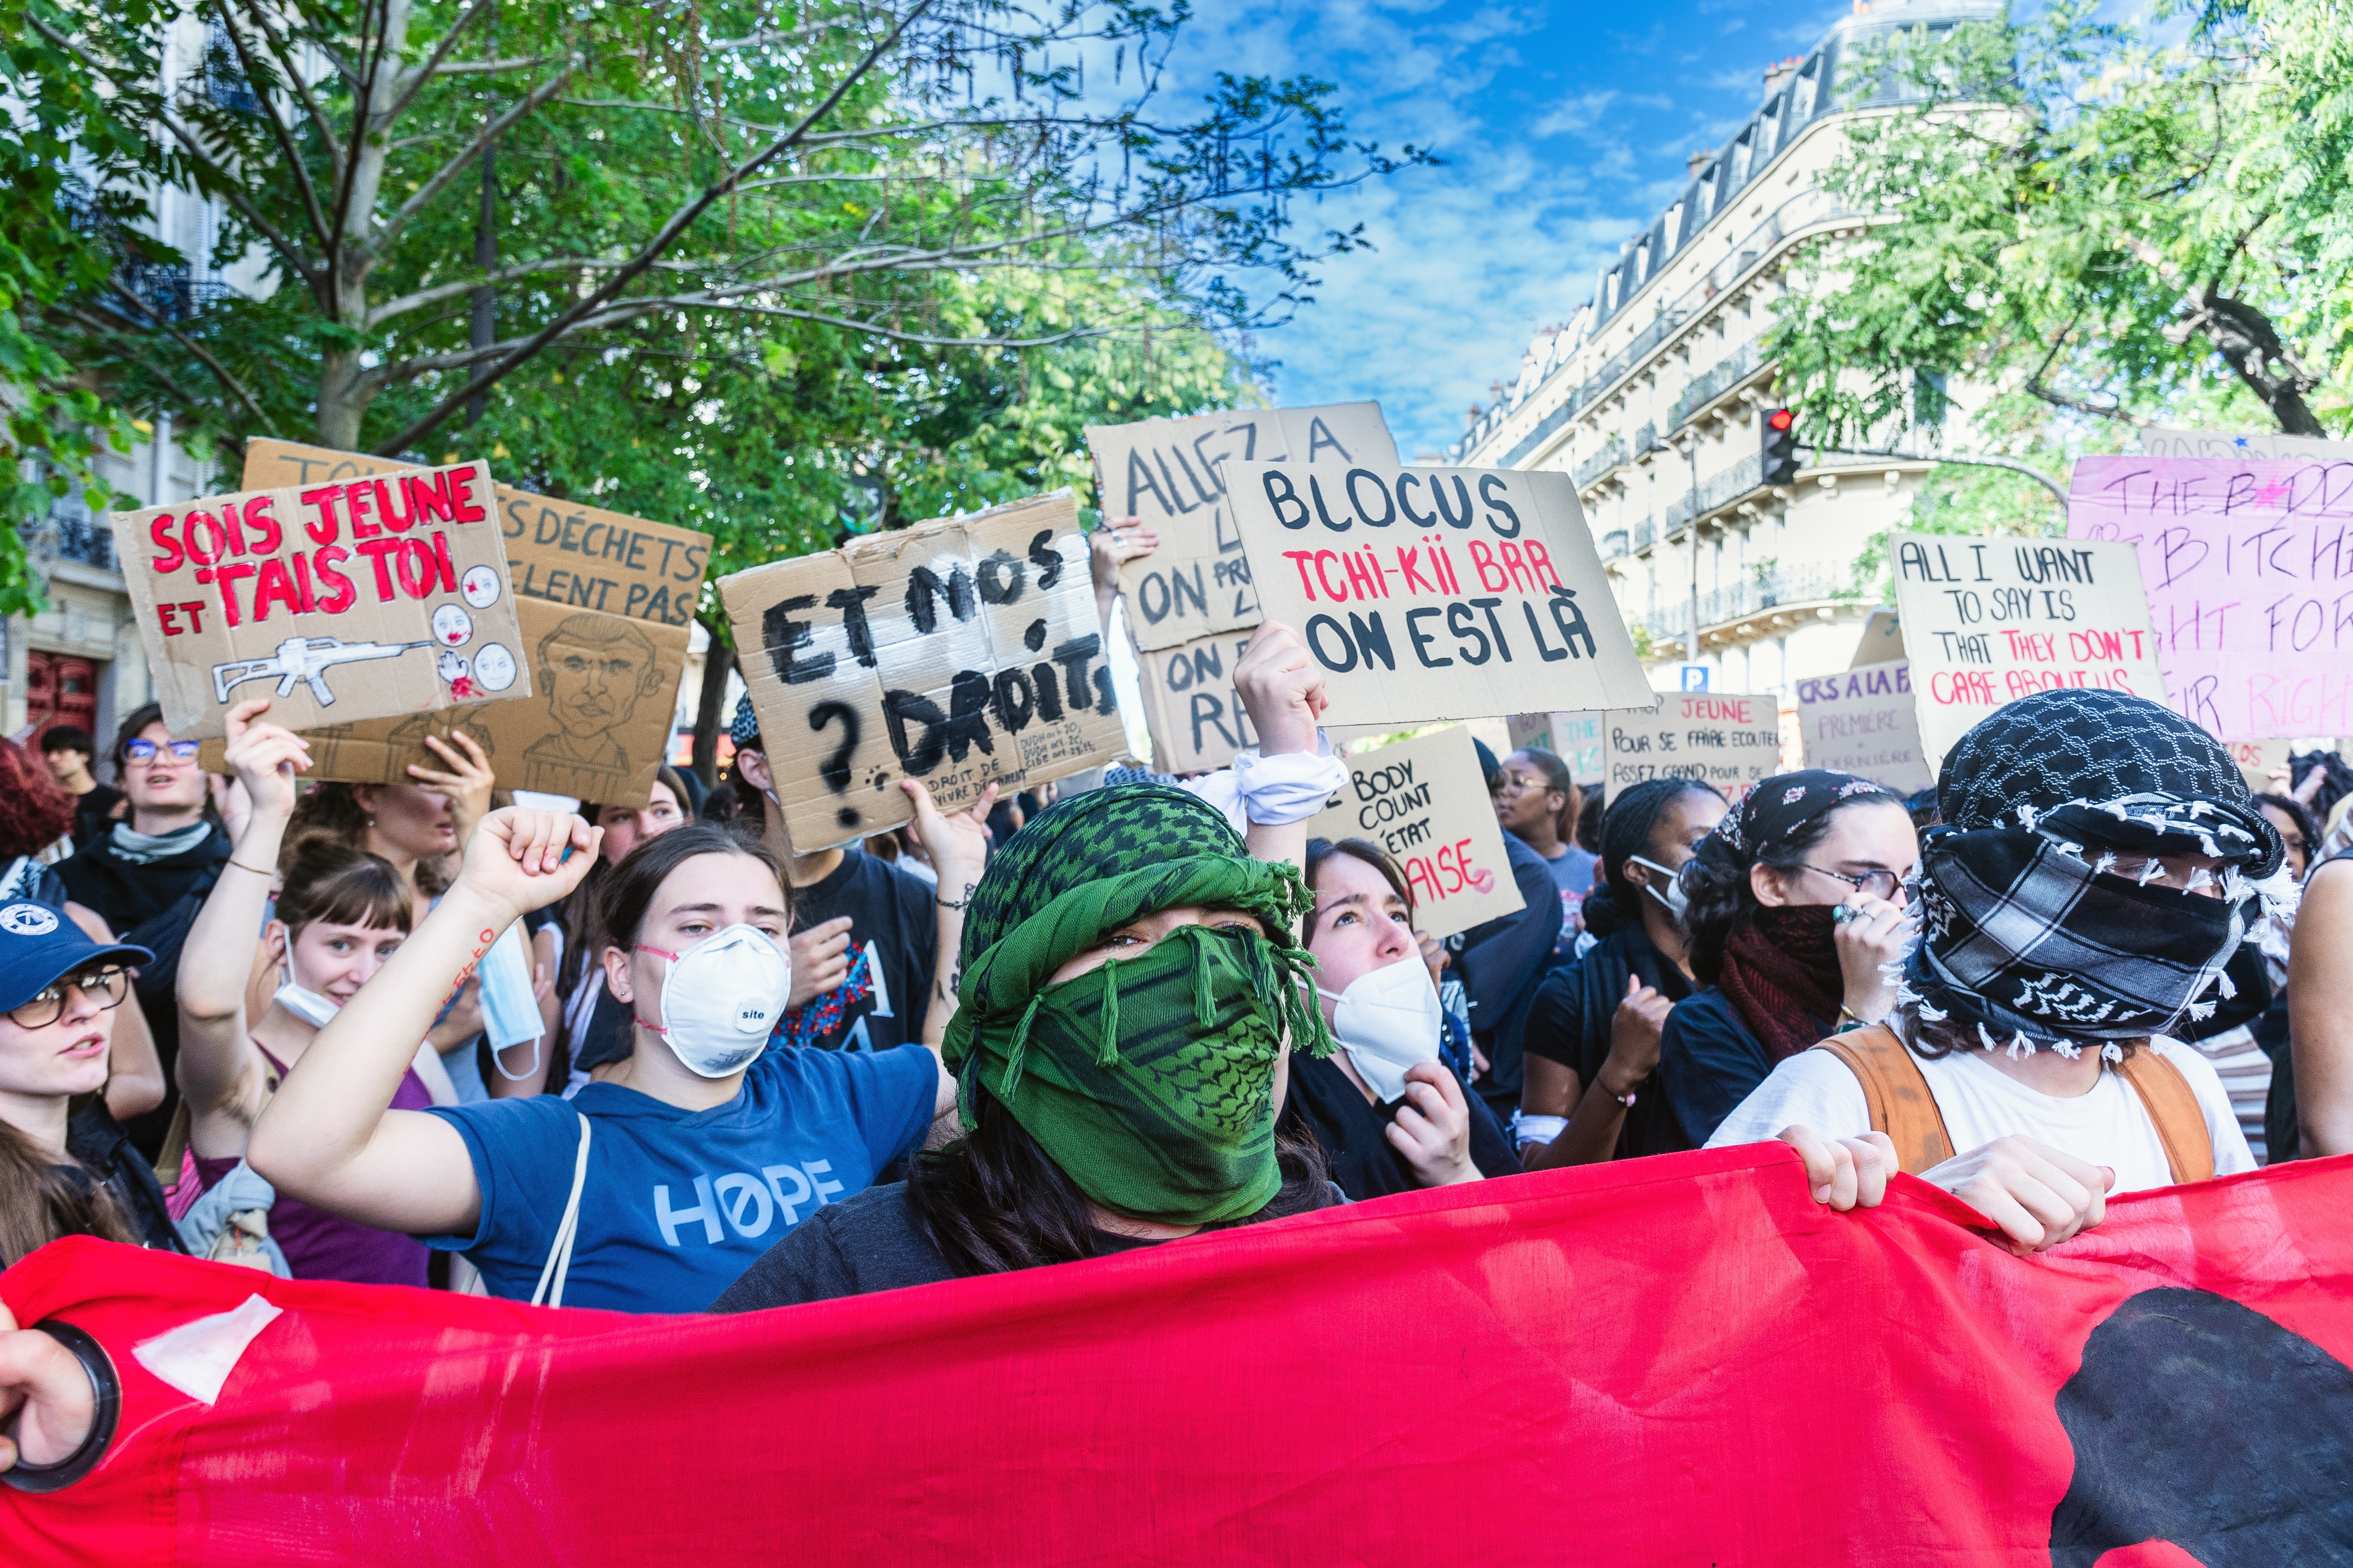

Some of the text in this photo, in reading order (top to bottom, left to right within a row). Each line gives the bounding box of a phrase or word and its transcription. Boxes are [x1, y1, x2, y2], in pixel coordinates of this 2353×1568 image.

[1127, 423, 1287, 517] ALLEZ
[1262, 467, 1522, 540] BLOCUS
[2104, 469, 2208, 516] THE
[150, 466, 486, 574] SOIS JEUNE
[535, 508, 707, 582] DÉCHETS
[1900, 542, 2094, 584] ALL I WANT
[625, 582, 694, 626] PAS
[763, 529, 1064, 684] ET NOS
[1139, 558, 1209, 625] ON
[1944, 588, 2075, 625] TO SAY IS
[156, 601, 205, 636] ET
[1305, 584, 1597, 674] ON EST LÀ
[1932, 627, 2144, 664] THAT THEY DON'T
[1167, 642, 1222, 693] ON
[1685, 669, 1703, 690] P
[1799, 676, 1838, 704] CRS
[1847, 674, 1862, 698] A
[1867, 670, 1891, 695] LA
[1932, 670, 2002, 706] CARE
[1681, 698, 1753, 723] JEUNE
[1613, 727, 1652, 754] POUR
[1659, 732, 1677, 751] SE
[928, 758, 1000, 793] DROIT DE
[1352, 759, 1414, 802] BODY
[1613, 763, 1656, 784] ASSEZ
[1662, 762, 1707, 781] GRAND
[1710, 766, 1740, 780] POUR
[933, 788, 970, 807] VIVRE
[1359, 783, 1432, 830] COUNT
[1380, 817, 1432, 855] 'ETAT
[1403, 838, 1486, 909] AISE
[742, 1009, 765, 1020] site
